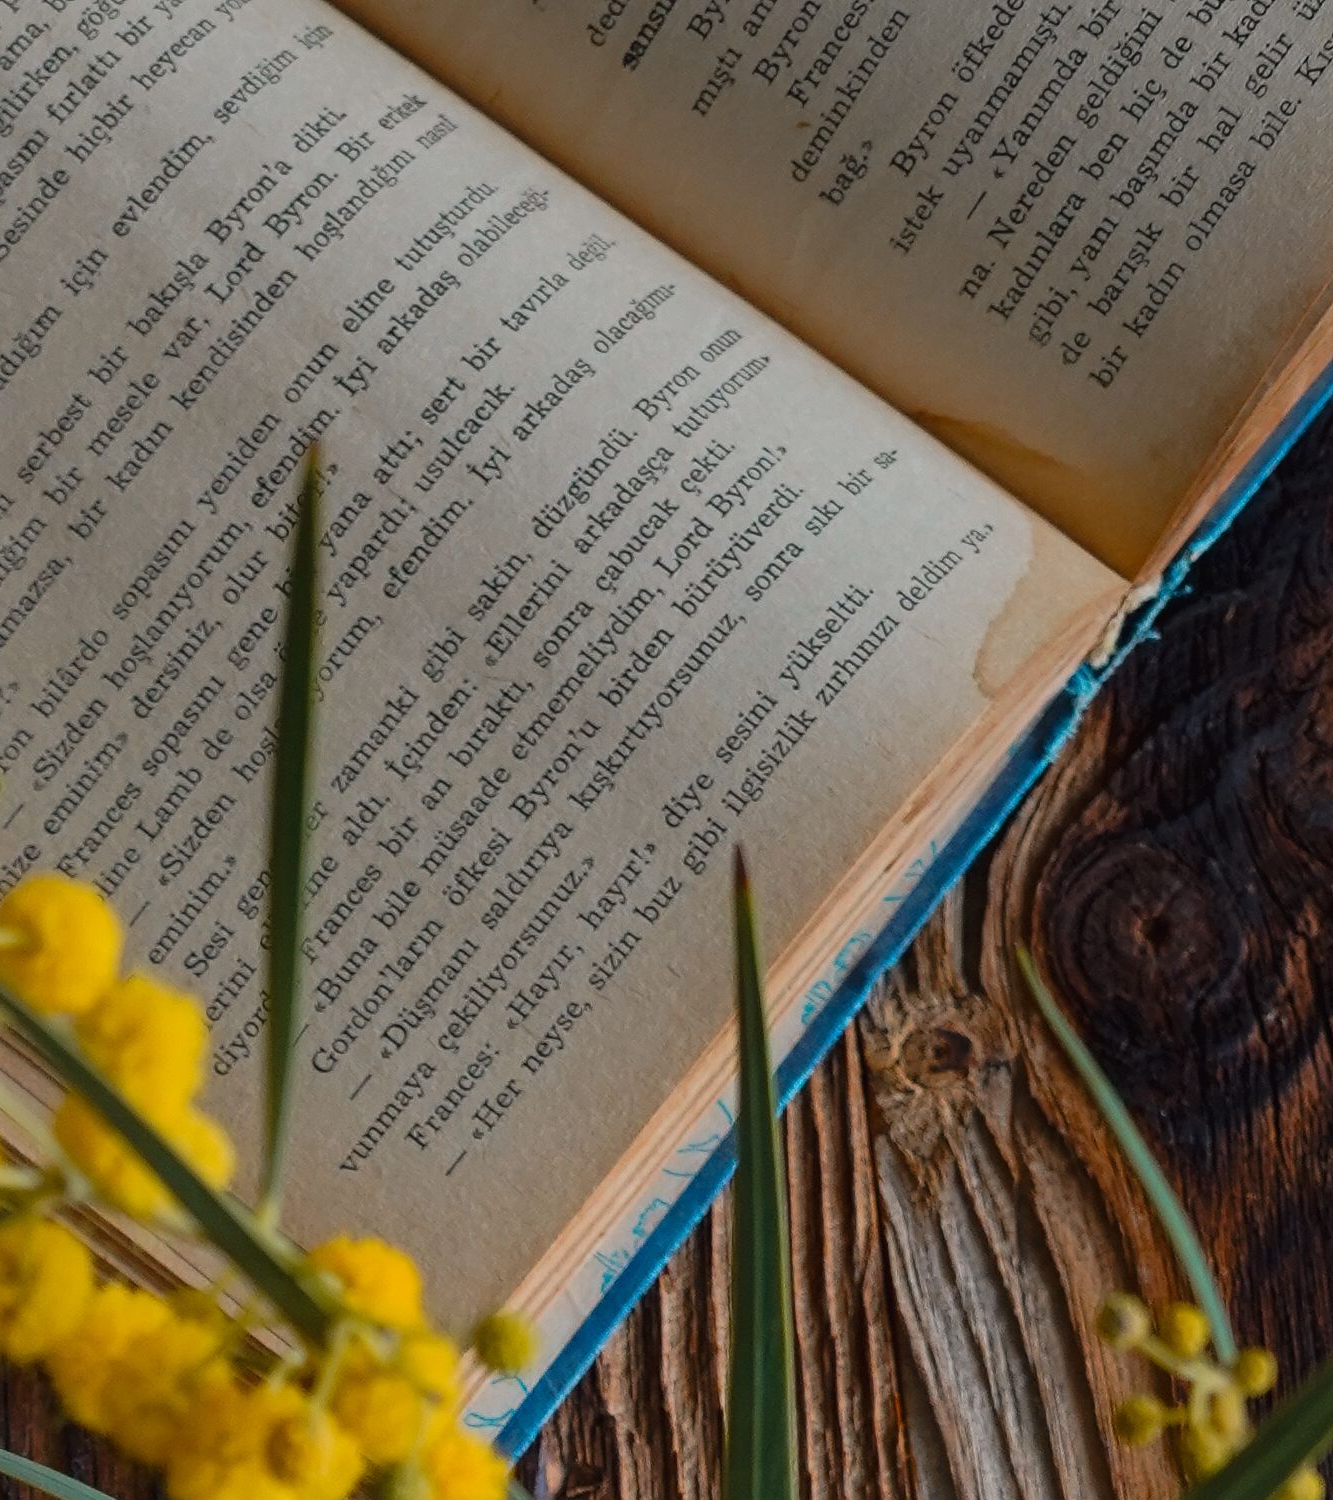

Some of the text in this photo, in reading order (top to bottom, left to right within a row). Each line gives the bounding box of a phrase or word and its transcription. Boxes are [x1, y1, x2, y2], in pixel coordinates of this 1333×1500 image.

[58, 247, 110, 298] için
[111, 134, 217, 239] evlendim,
[888, 3, 1074, 255] istek uyanmamıştı.
[957, 5, 1165, 300] na. Nereden geldiğini
[986, 34, 1198, 322] kadınlara ben hiç de
[1068, 216, 1121, 283] yanı
[1107, 100, 1201, 211] başımda
[1187, 49, 1233, 95] bir
[1087, 97, 1304, 390] bir kadın olmasa bile.
[16, 393, 94, 486] serbest
[85, 344, 130, 387] bir
[124, 252, 211, 338] bakışla
[402, 583, 875, 1152] Frances: «Hayır, hayır!» diye sesini yükseltti.
[470, 1077, 525, 1141] «Her
[587, 929, 643, 992] sizin
[631, 875, 686, 926] buz
[681, 815, 729, 877] gibi
[720, 708, 819, 818] ilgisizlik
[814, 613, 902, 709] zırhınızı
[895, 549, 965, 613] deldim
